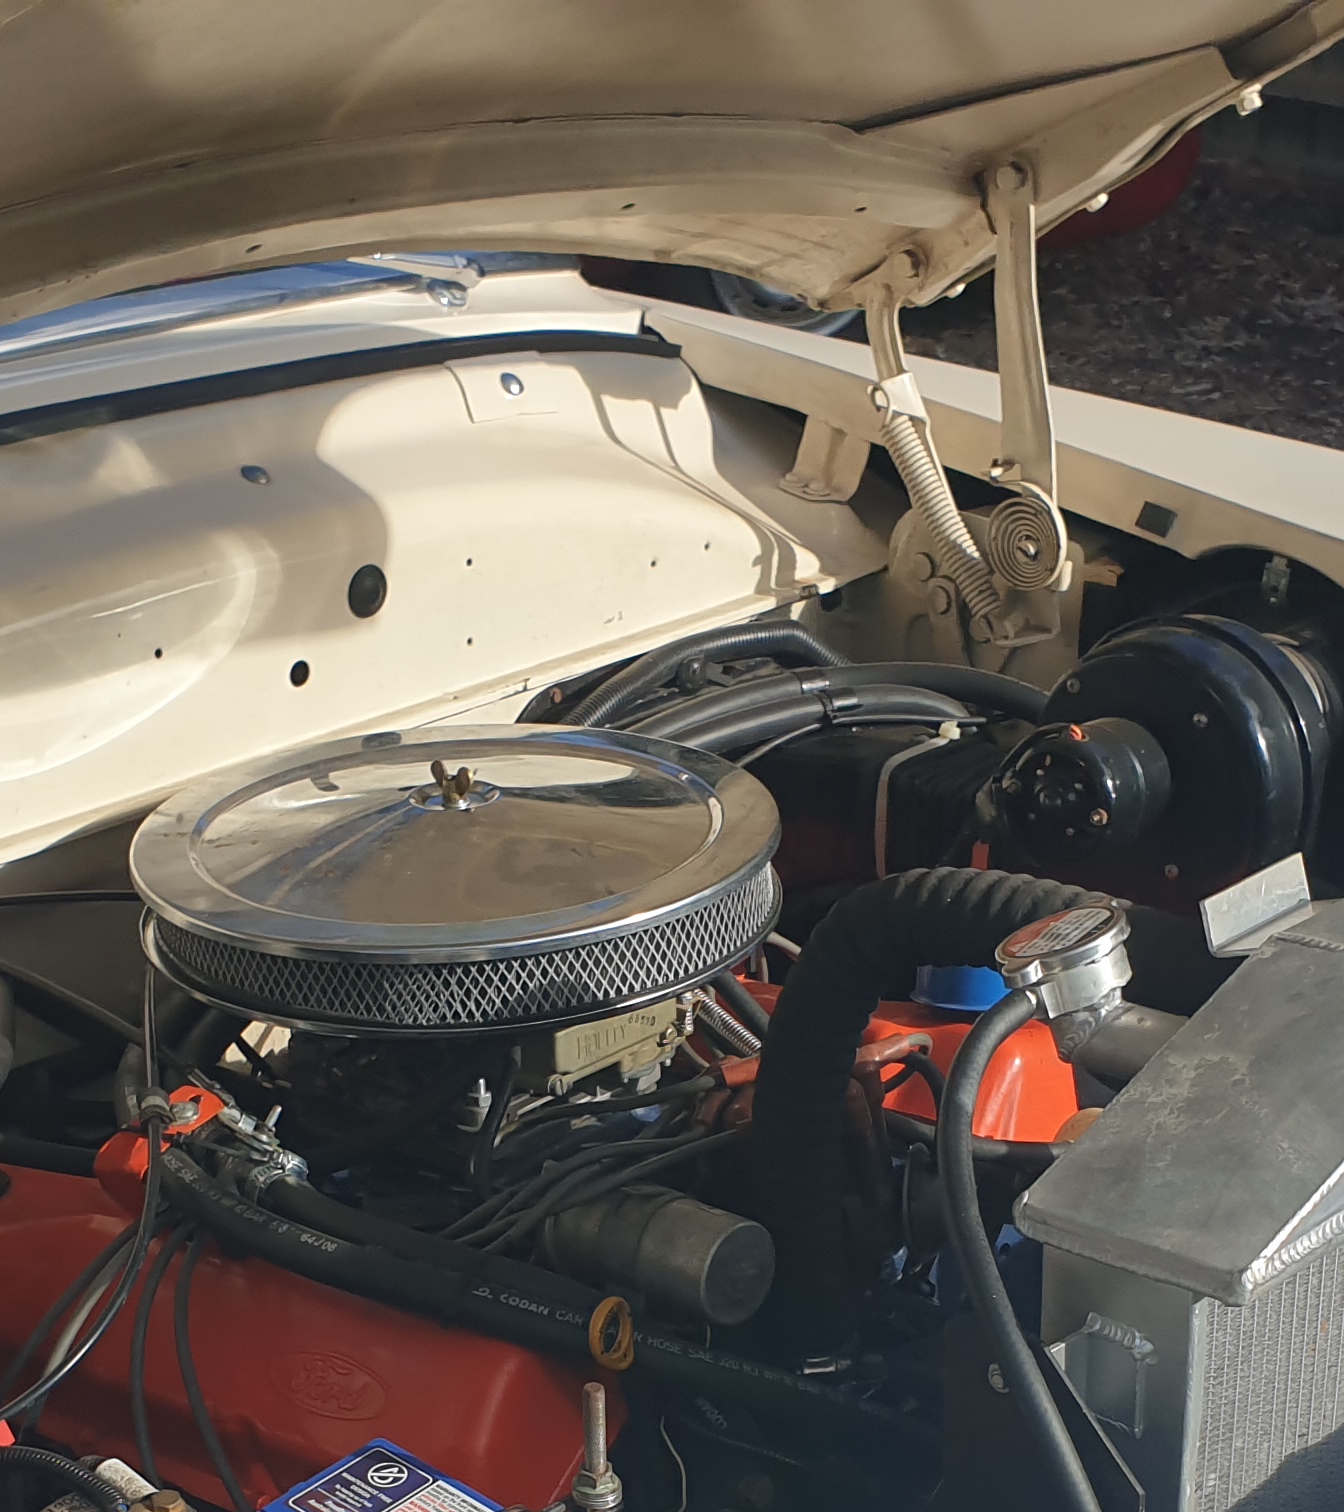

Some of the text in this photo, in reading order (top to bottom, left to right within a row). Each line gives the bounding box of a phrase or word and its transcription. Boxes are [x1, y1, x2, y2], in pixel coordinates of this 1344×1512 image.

[499, 1293, 550, 1317] CODAN
[555, 1309, 584, 1327] CAR
[647, 1334, 683, 1355] HOSE
